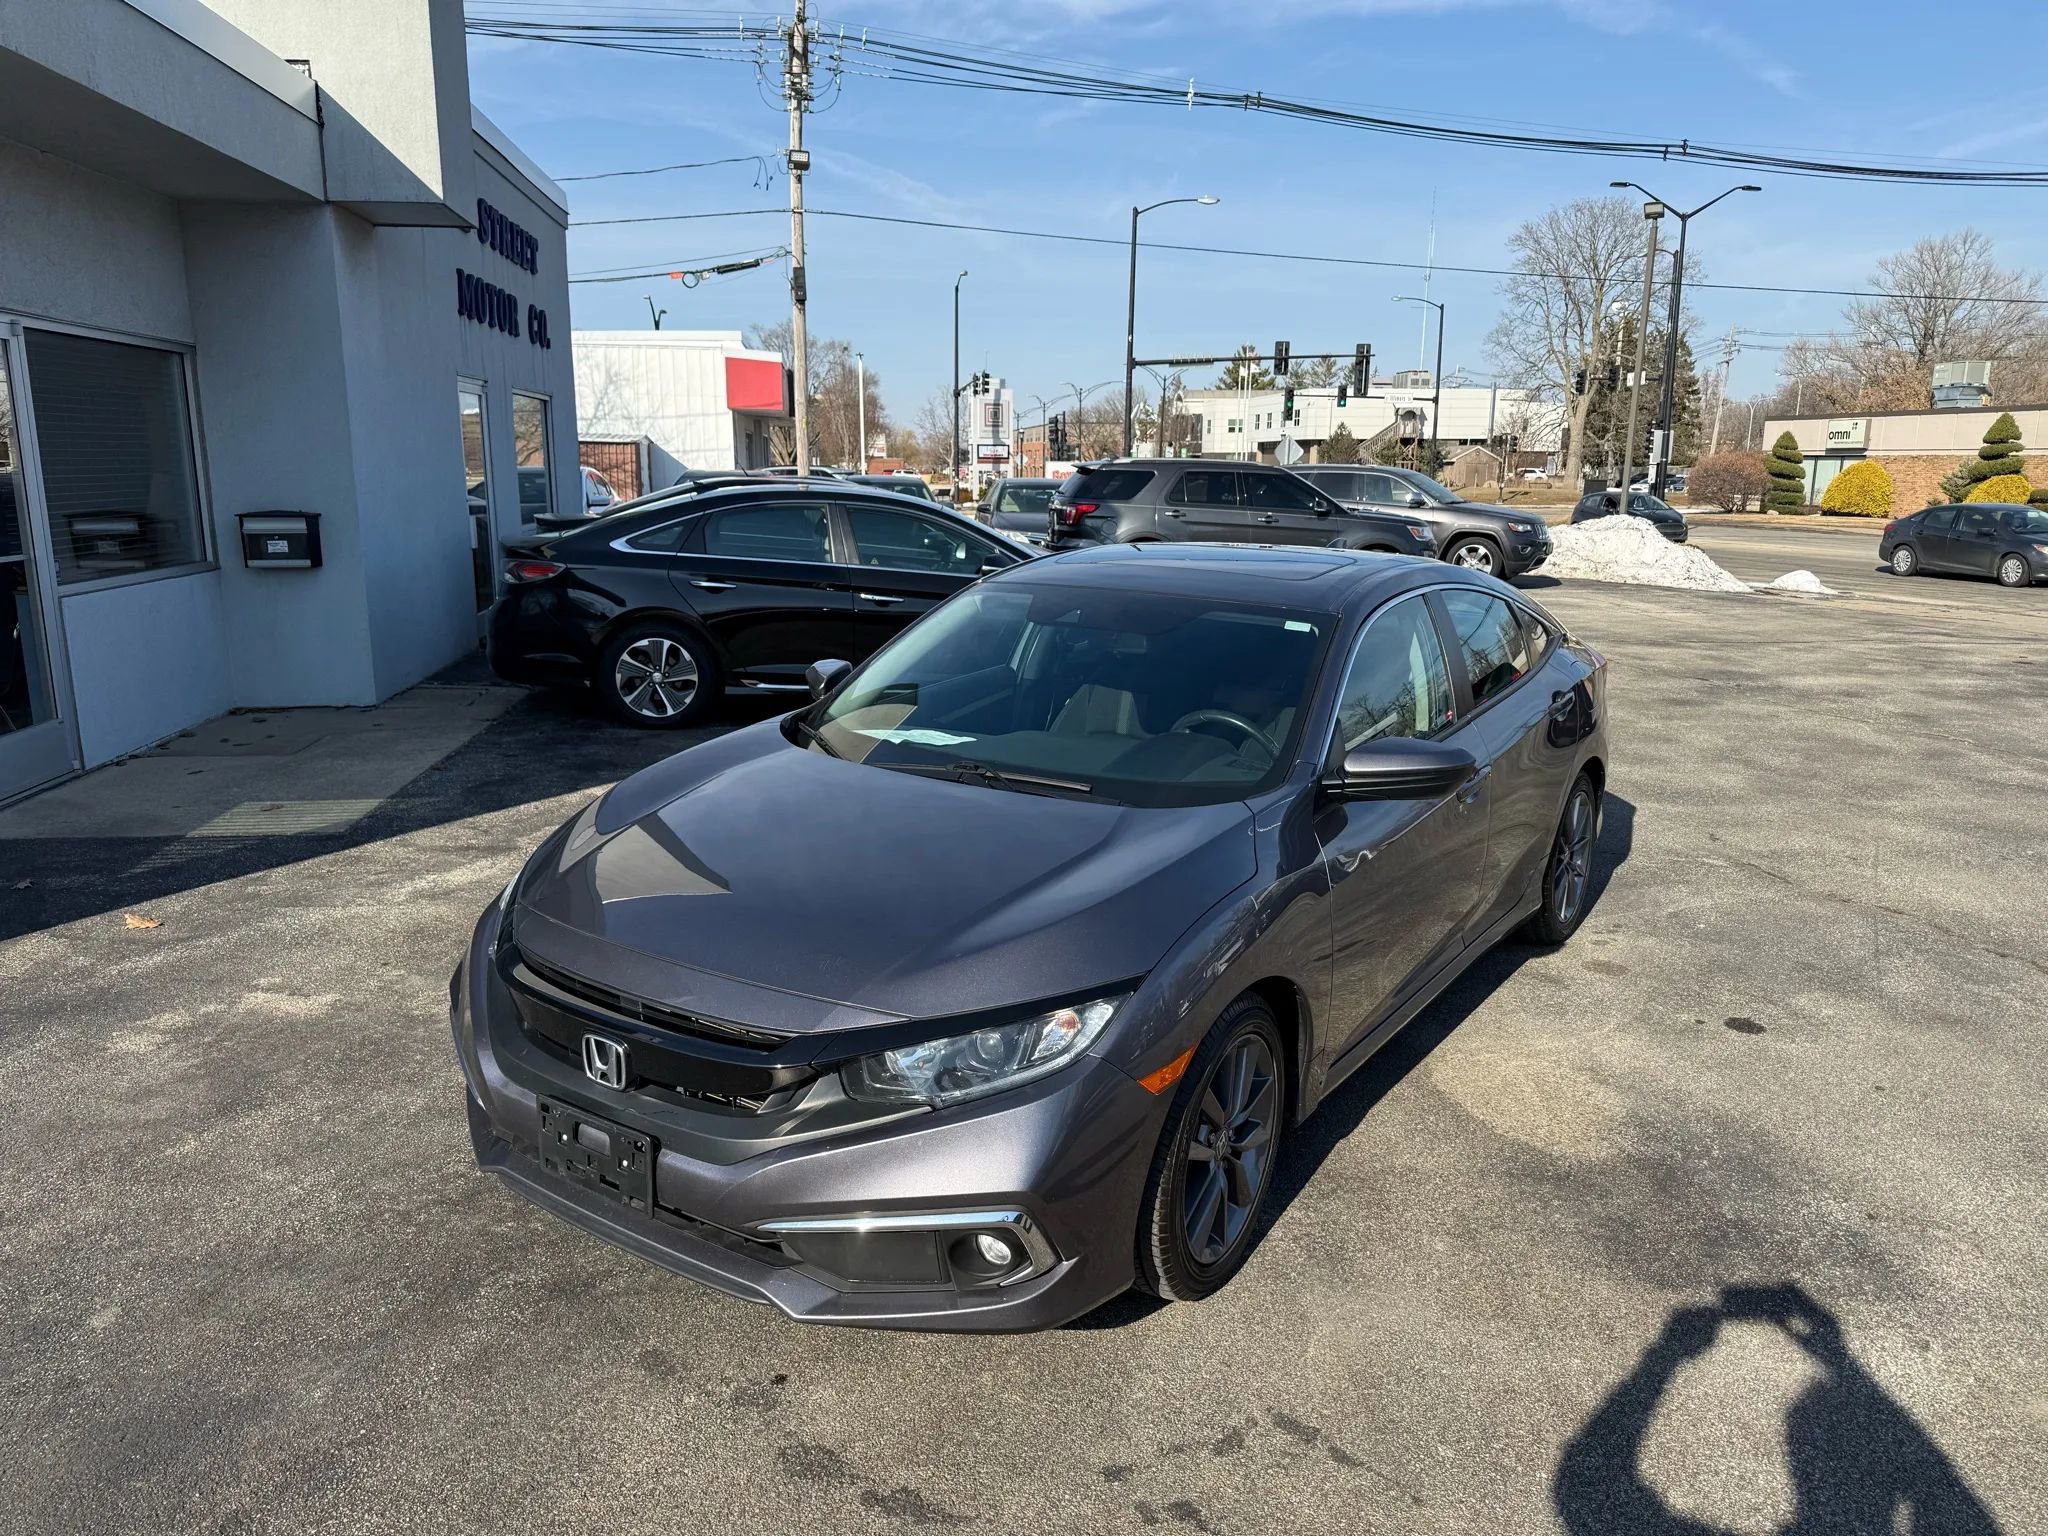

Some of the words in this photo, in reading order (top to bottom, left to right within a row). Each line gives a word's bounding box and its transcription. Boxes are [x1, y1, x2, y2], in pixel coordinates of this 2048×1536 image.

[477, 198, 538, 275] STREET
[456, 268, 520, 338] MOTOR
[528, 304, 551, 350] CO.
[1828, 430, 1851, 440] omni
